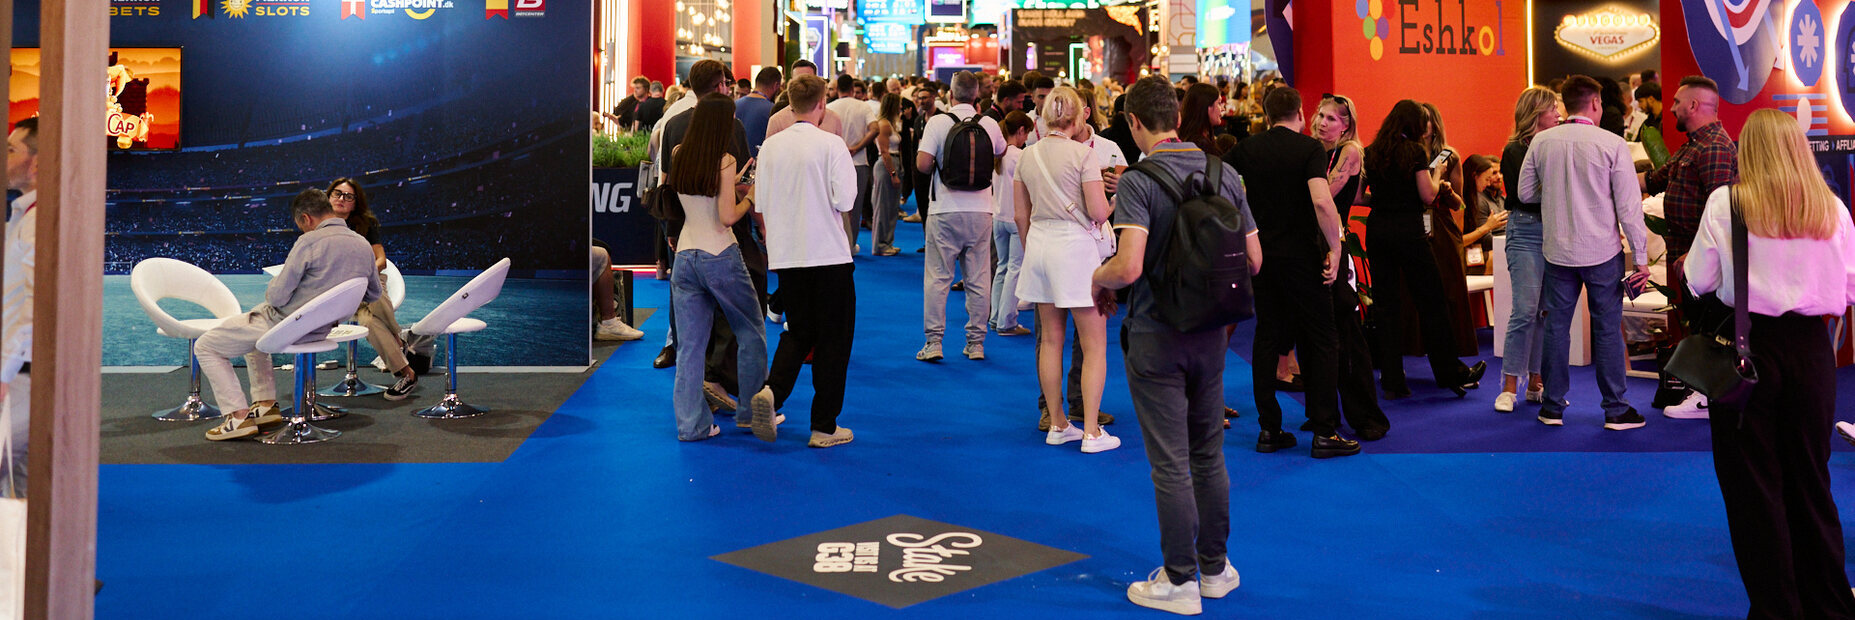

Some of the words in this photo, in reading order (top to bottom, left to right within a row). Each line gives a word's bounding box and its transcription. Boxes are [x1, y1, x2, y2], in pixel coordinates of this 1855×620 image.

[109, 6, 160, 16] BETS
[255, 6, 310, 16] SLOTS
[1399, 0, 1505, 56] Eshkol
[1590, 35, 1625, 45] VEGAS
[813, 542, 856, 573] G38
[886, 532, 983, 583] Stake
